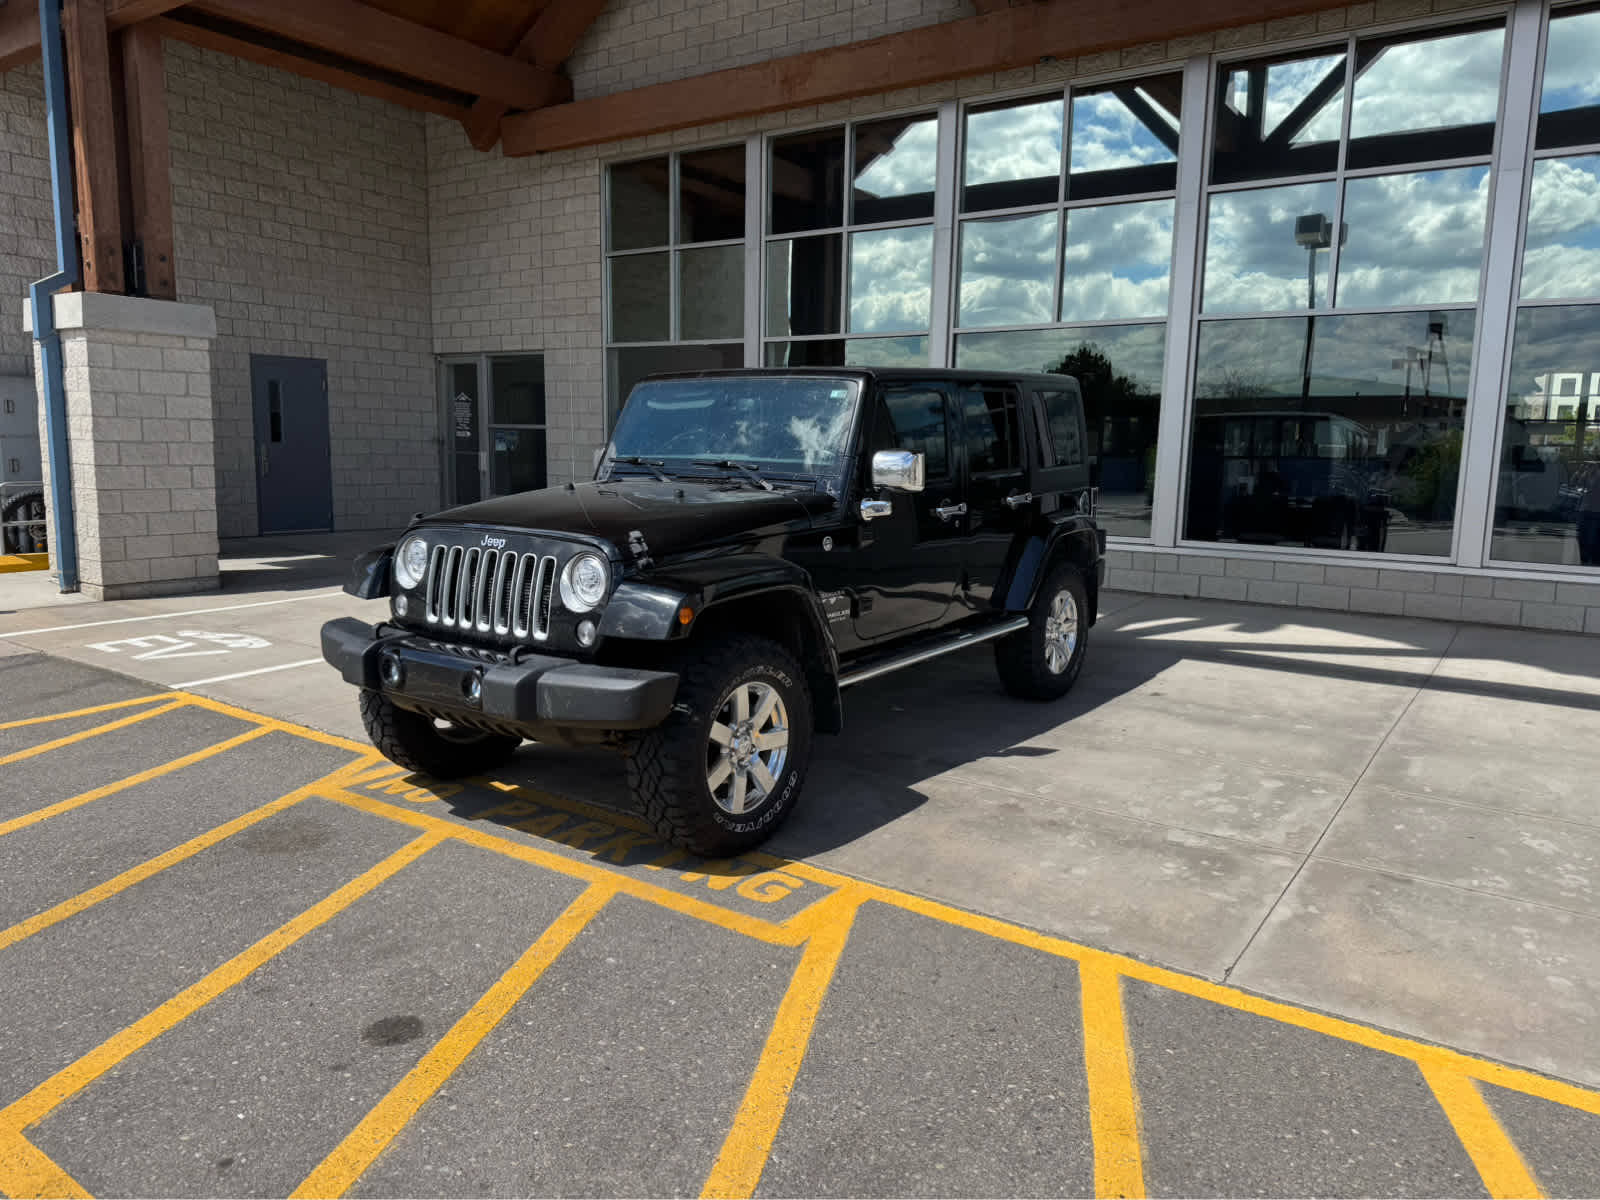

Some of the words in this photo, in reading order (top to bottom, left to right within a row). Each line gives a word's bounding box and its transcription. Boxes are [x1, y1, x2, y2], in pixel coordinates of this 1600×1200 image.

[480, 534, 506, 550] Jeep
[85, 634, 232, 660] EV
[366, 772, 464, 803] NO
[470, 801, 804, 903] PARKING
